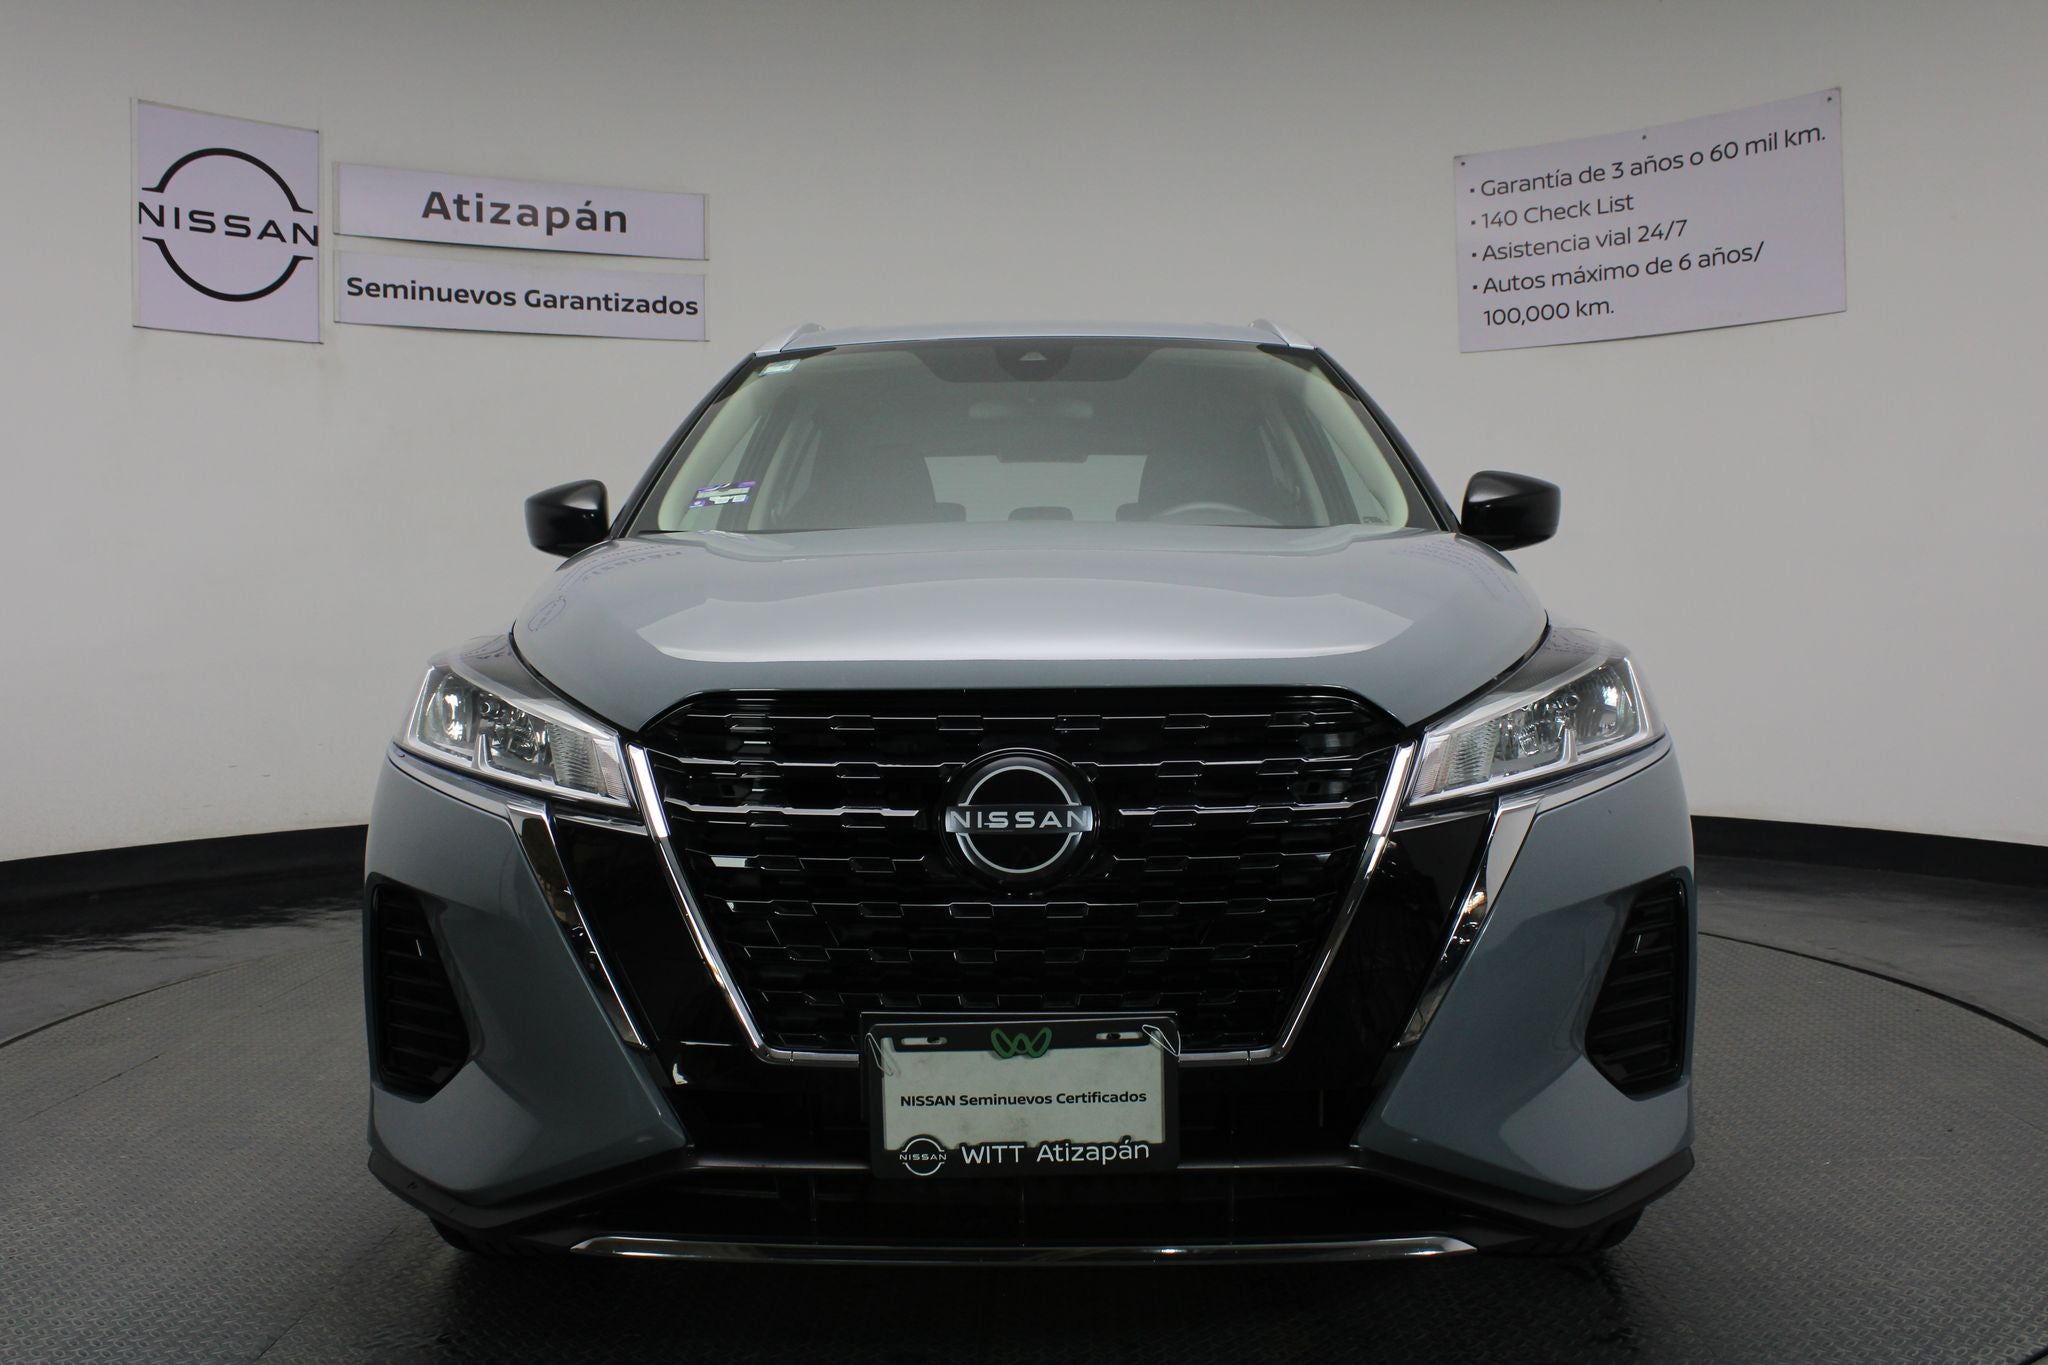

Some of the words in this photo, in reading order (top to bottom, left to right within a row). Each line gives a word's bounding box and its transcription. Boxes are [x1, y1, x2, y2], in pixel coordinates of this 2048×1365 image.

[1481, 168, 1573, 197] Garantía
[1579, 165, 1606, 184] de
[1611, 161, 1625, 180] 3
[1630, 153, 1685, 177] años
[1689, 151, 1705, 166] o
[1710, 141, 1739, 162] 60
[1745, 132, 1778, 155] mil
[1784, 125, 1826, 147] km.
[138, 201, 319, 247] NISSAN
[421, 191, 629, 236] Atizapán
[1481, 210, 1518, 229] 140
[1524, 199, 1592, 225] Check
[1597, 193, 1635, 215] List
[1482, 233, 1591, 262] Asistencia
[1595, 227, 1632, 249] vial
[1637, 219, 1688, 244] 24/7
[1482, 272, 1546, 295] Autos
[1552, 262, 1640, 288] máximo
[1646, 255, 1673, 276] de
[1678, 253, 1693, 271] 6
[1697, 240, 1765, 269] años/
[346, 276, 517, 307] Seminuevos
[523, 289, 699, 316] Garantizados
[1483, 302, 1570, 328] 100,000
[1576, 298, 1615, 319] km.
[949, 810, 1087, 829] NISSAN
[900, 1095, 956, 1107] NISSAN
[959, 1093, 1053, 1106] Seminuevos
[1056, 1090, 1147, 1104] Certificados
[899, 1152, 947, 1161] NISSAN
[961, 1145, 1025, 1164] WITT
[1036, 1135, 1150, 1165] Atizapán
